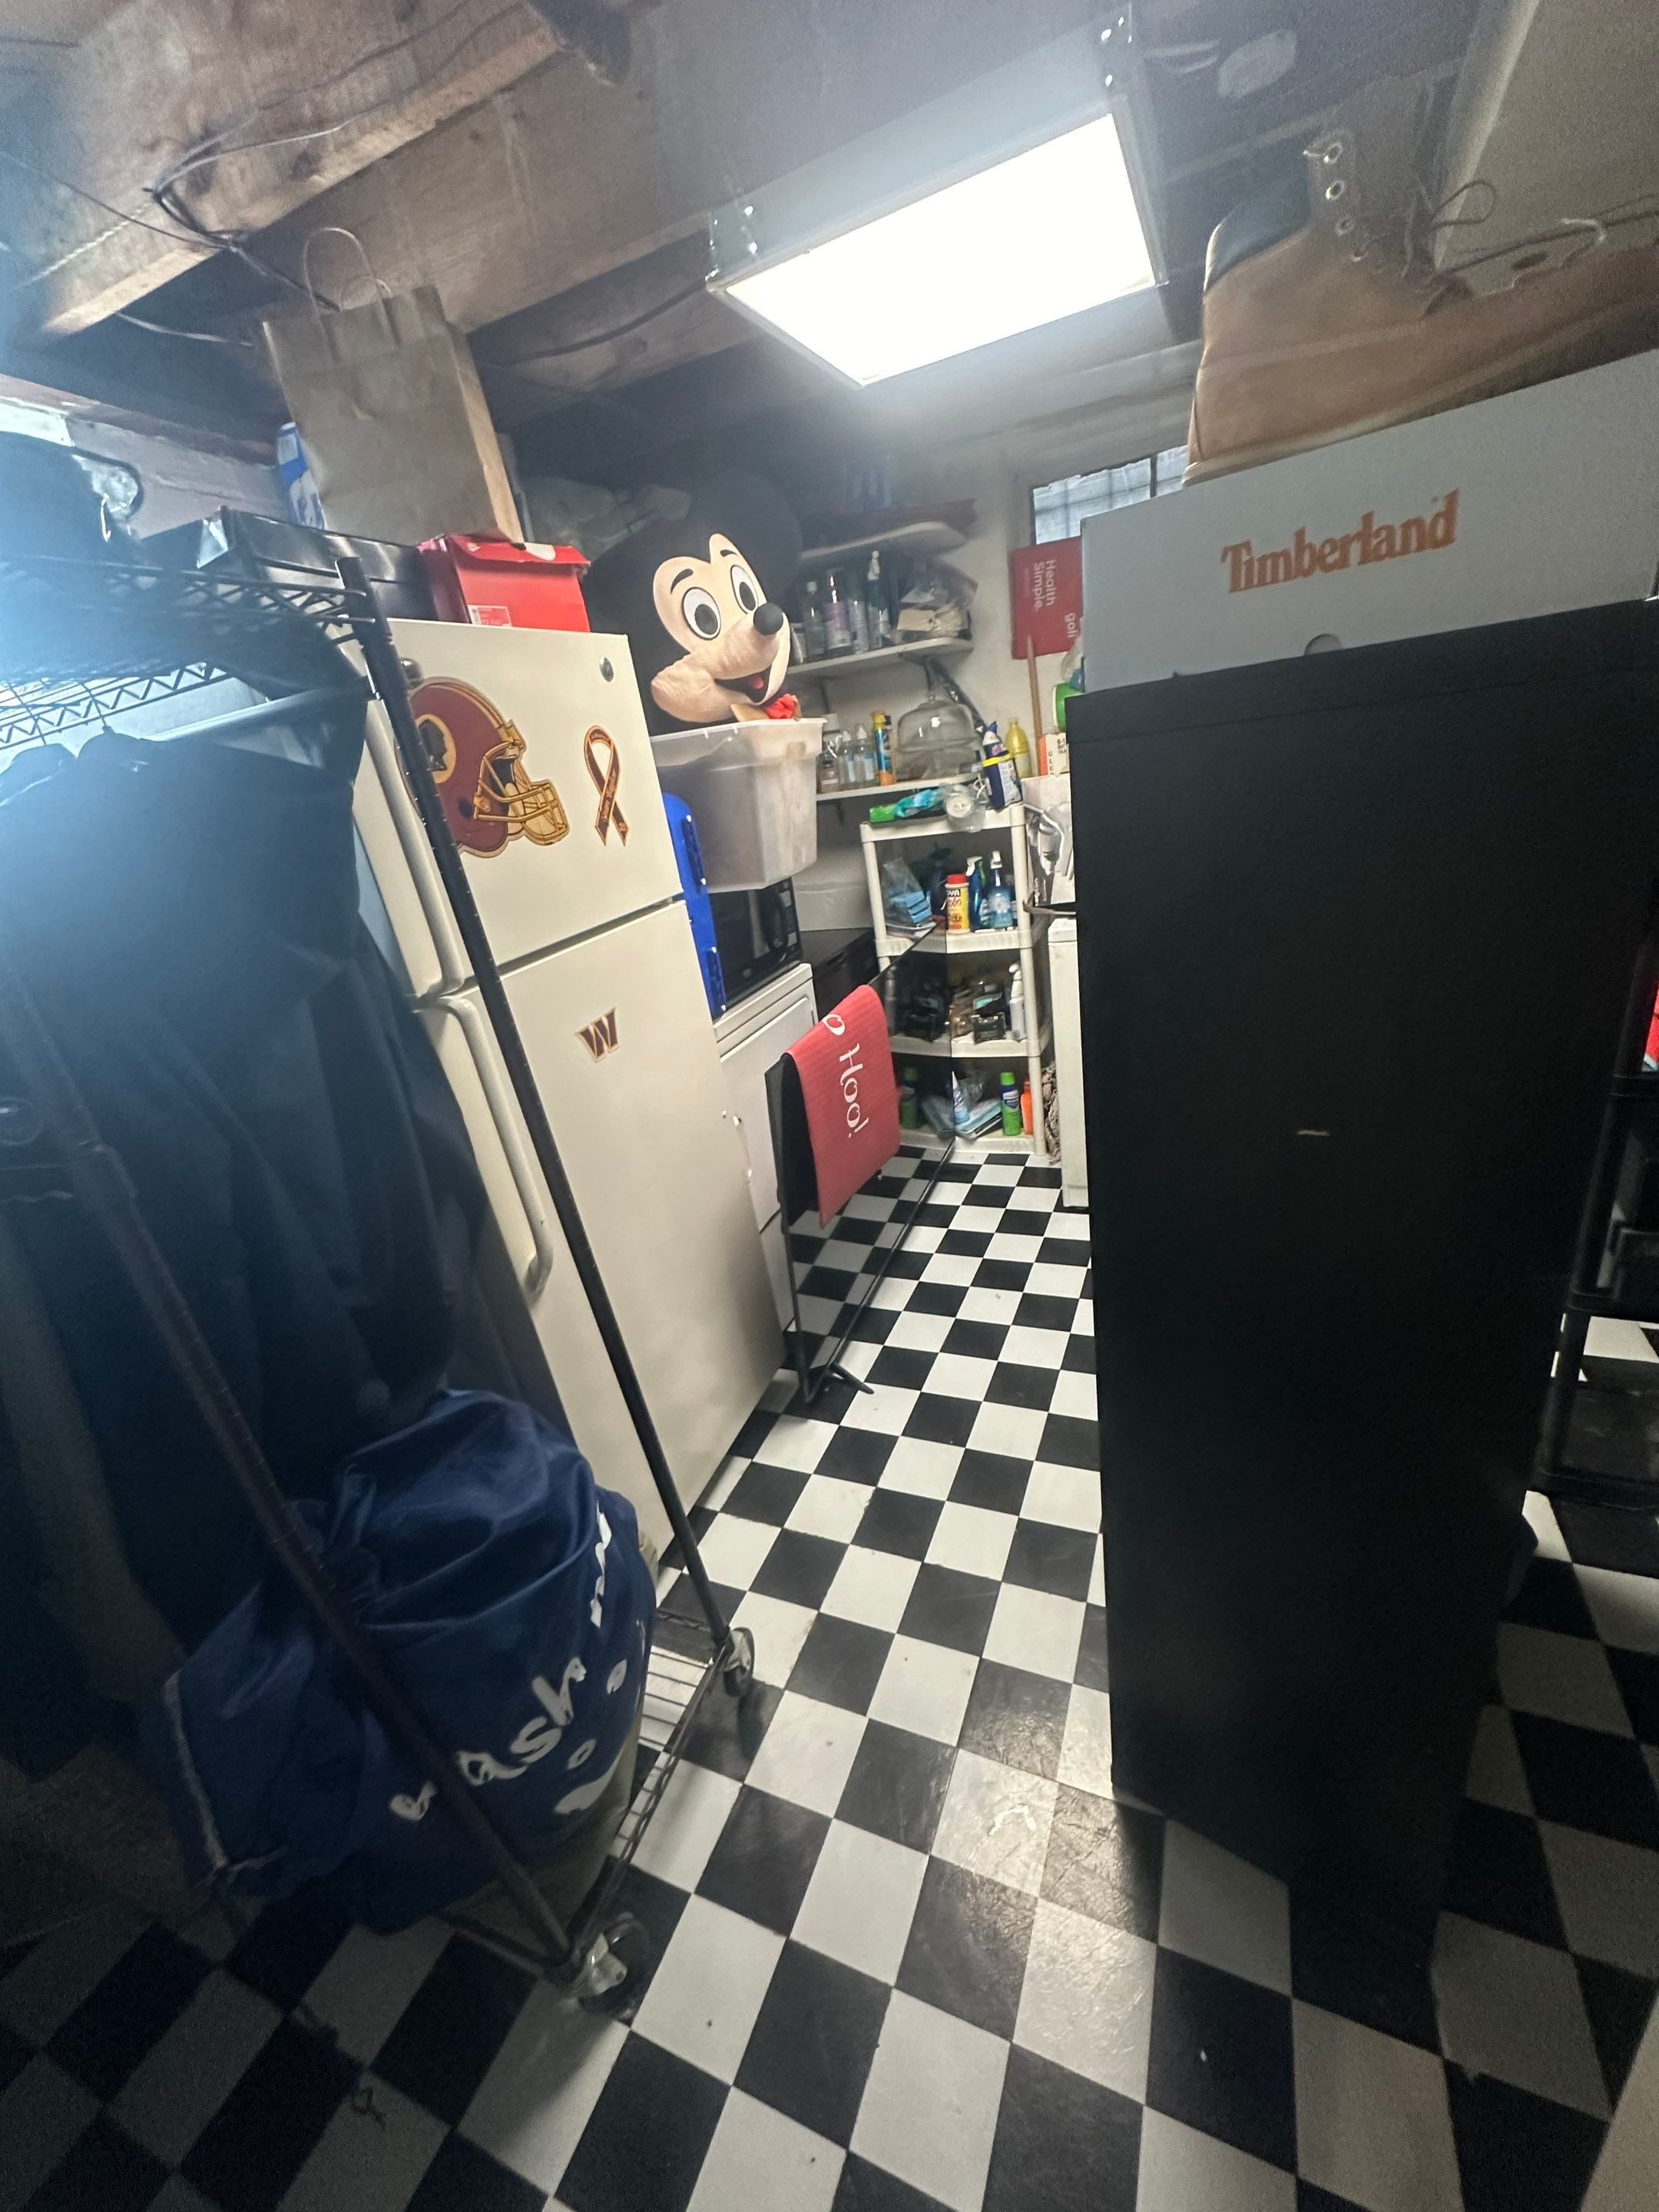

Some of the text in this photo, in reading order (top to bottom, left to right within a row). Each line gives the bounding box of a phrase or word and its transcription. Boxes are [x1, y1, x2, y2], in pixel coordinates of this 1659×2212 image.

[1220, 489, 1459, 594] Timberland
[1045, 559, 1057, 607] Health
[1065, 613, 1078, 638] goli
[575, 1006, 620, 1063] W
